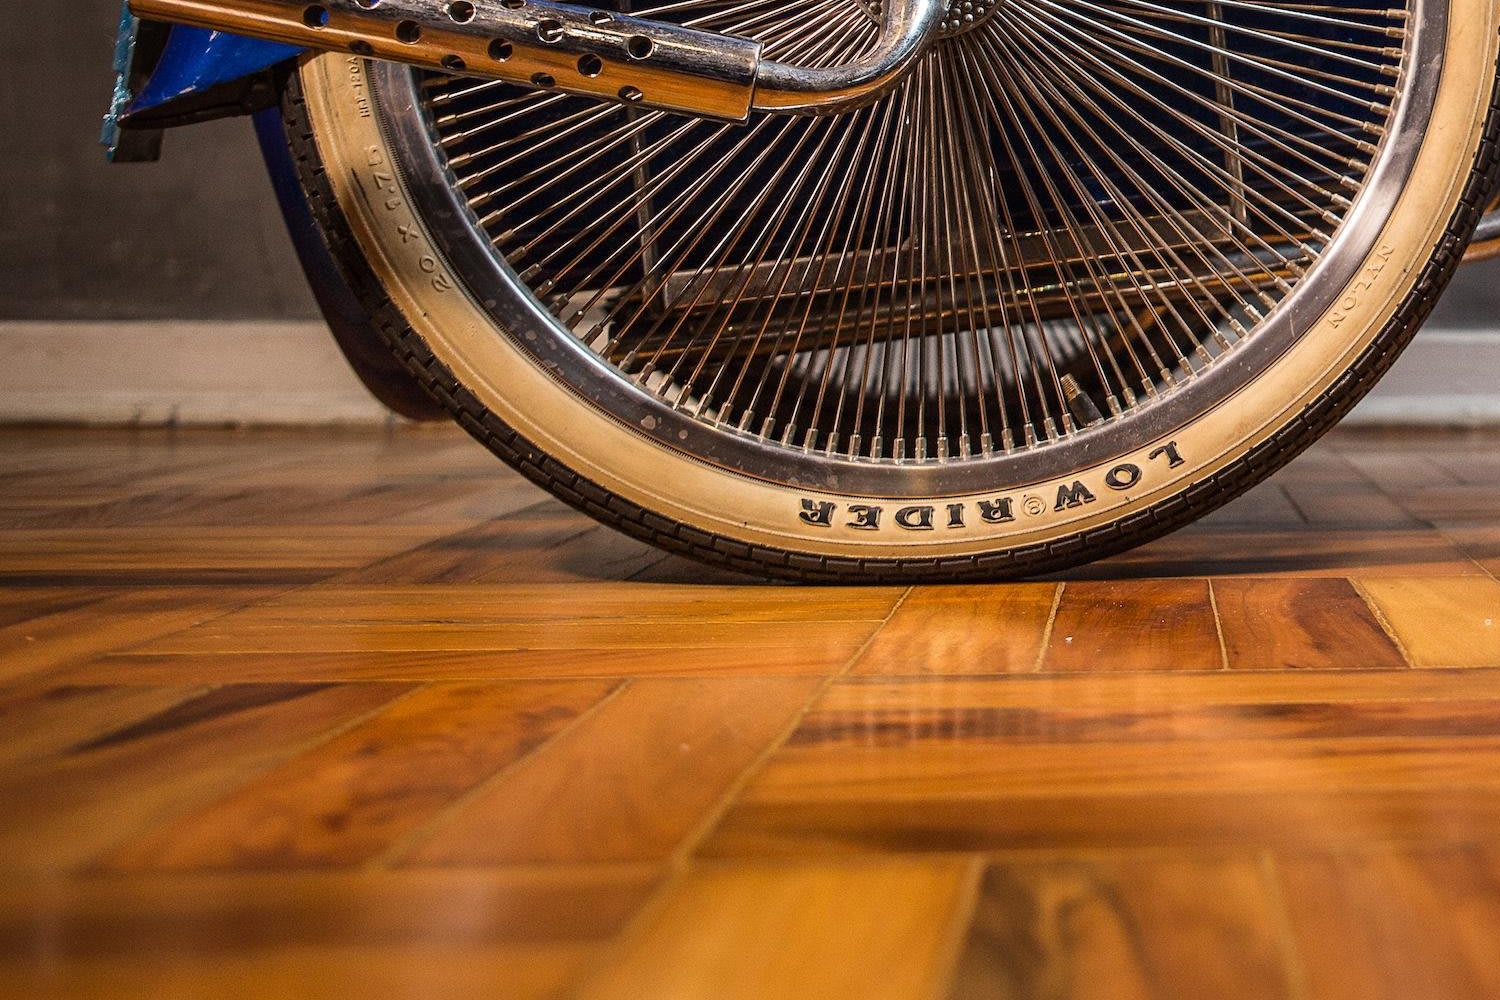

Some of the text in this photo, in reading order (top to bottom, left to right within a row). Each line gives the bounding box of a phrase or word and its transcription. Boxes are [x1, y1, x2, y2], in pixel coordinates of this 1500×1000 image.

[368, 145, 401, 211] 1.75
[419, 254, 453, 292] 20
[1327, 245, 1395, 329] NYLON
[799, 440, 1187, 531] LOW RIDER
